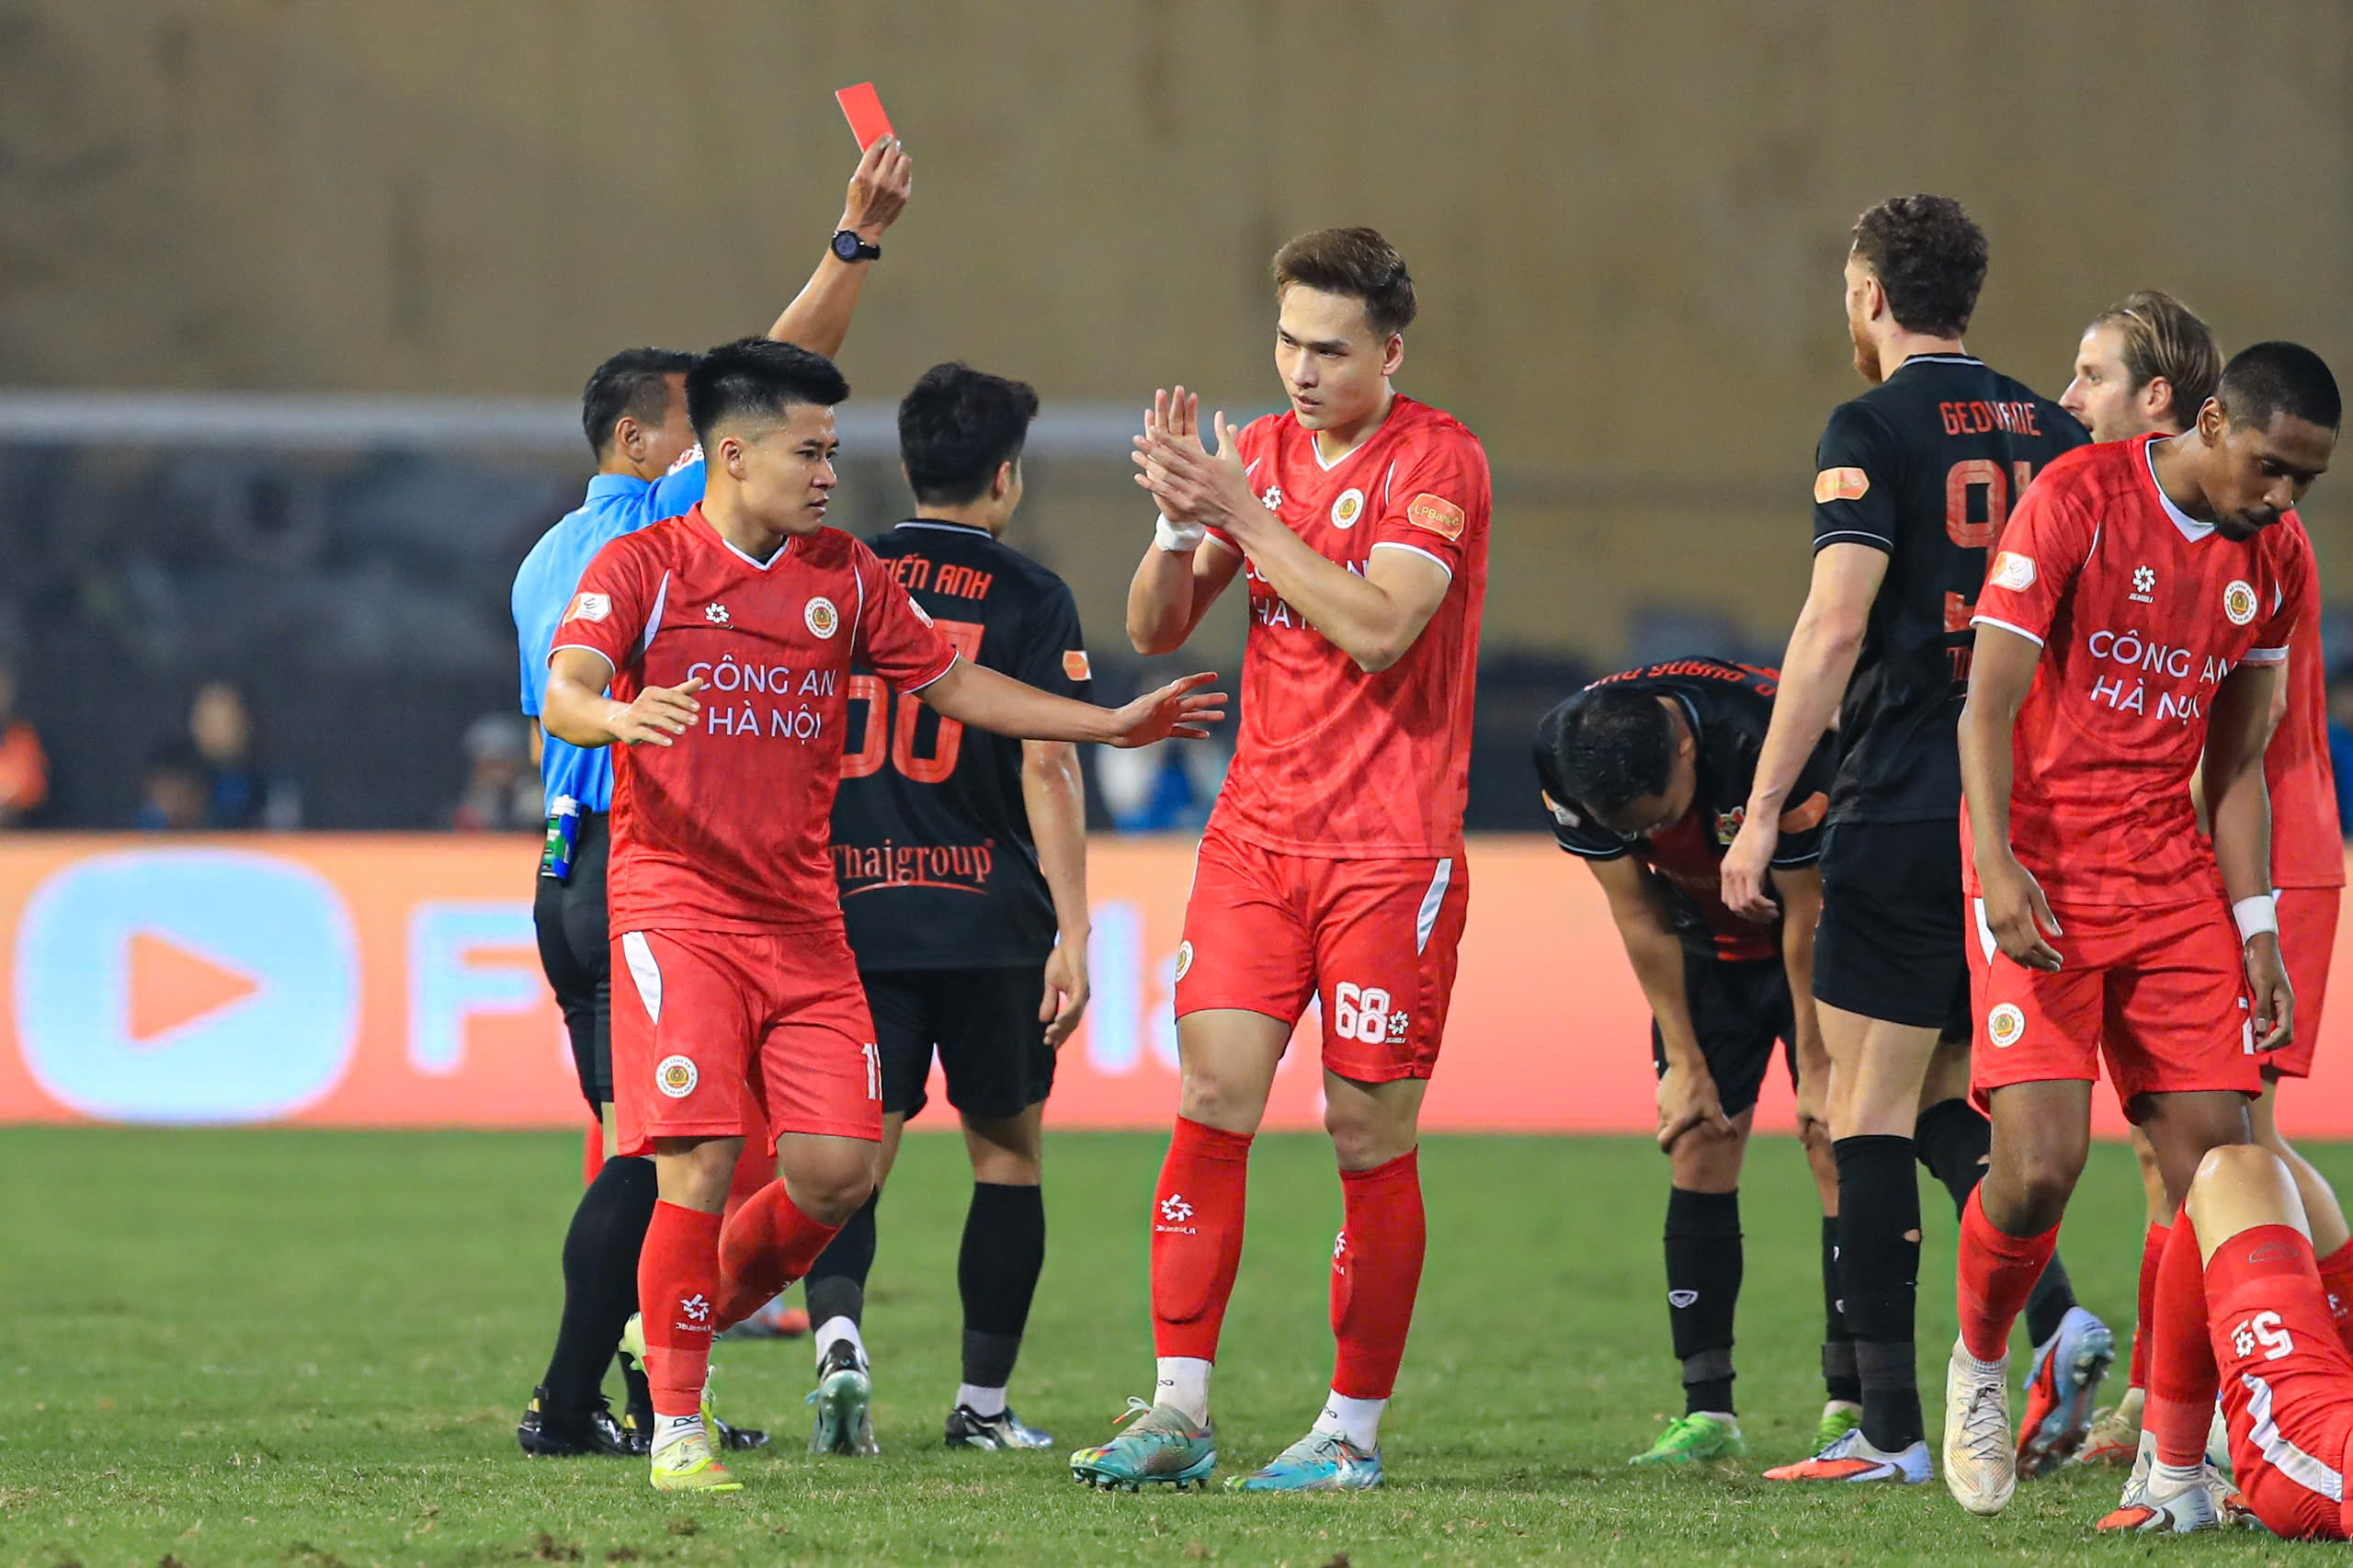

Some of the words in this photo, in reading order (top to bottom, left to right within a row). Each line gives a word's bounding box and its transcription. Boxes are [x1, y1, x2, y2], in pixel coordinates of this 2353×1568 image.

[1414, 504, 1451, 527] LPBan
[1944, 460, 2031, 633] 9
[933, 562, 993, 599] ANH
[687, 653, 790, 695] CÔNG
[798, 669, 836, 697] AN
[2088, 629, 2192, 678] CÔNG
[2090, 675, 2144, 716] HÀ
[708, 699, 760, 736] HÀ
[770, 703, 823, 746] NỘI
[1335, 981, 1392, 1044] 68
[2251, 1311, 2294, 1360] 5
